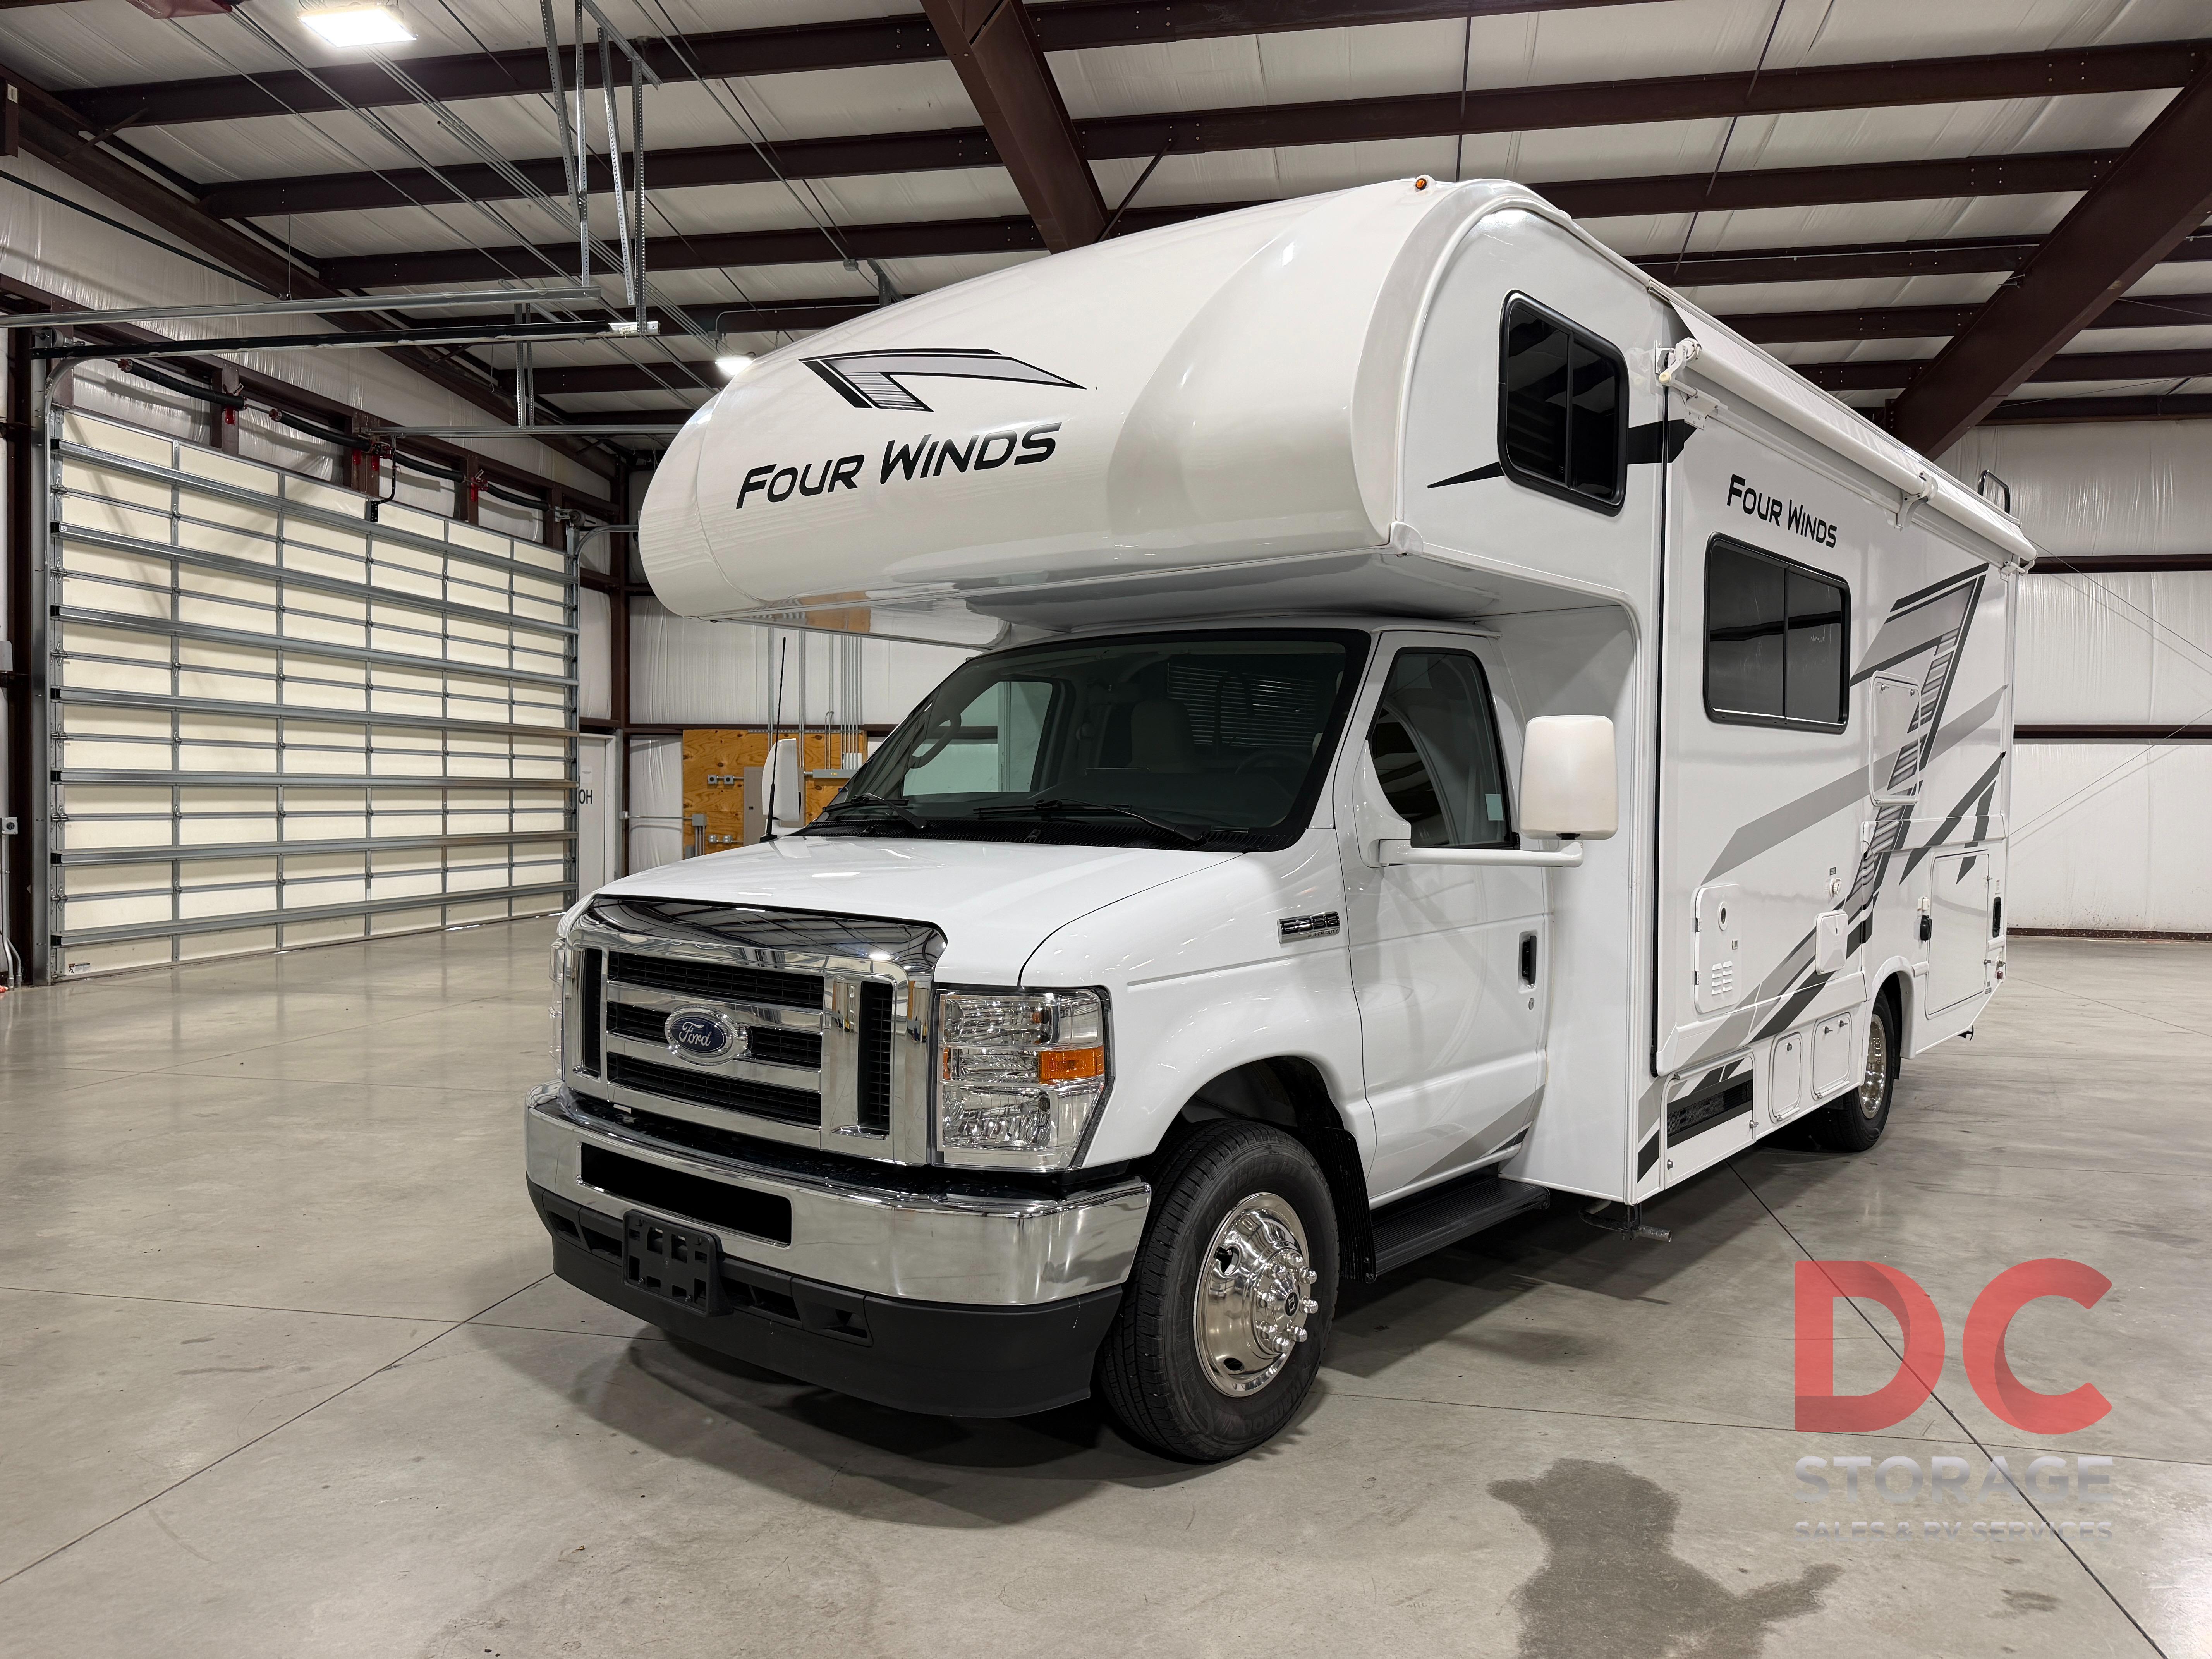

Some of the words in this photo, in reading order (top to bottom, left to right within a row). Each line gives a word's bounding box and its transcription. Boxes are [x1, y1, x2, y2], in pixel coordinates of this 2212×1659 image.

[736, 454, 865, 509] FOUR
[880, 422, 1062, 484] WINDS
[1727, 474, 1783, 527] FOUR
[1788, 499, 1837, 548] WINDS
[679, 1022, 712, 1046] Ford
